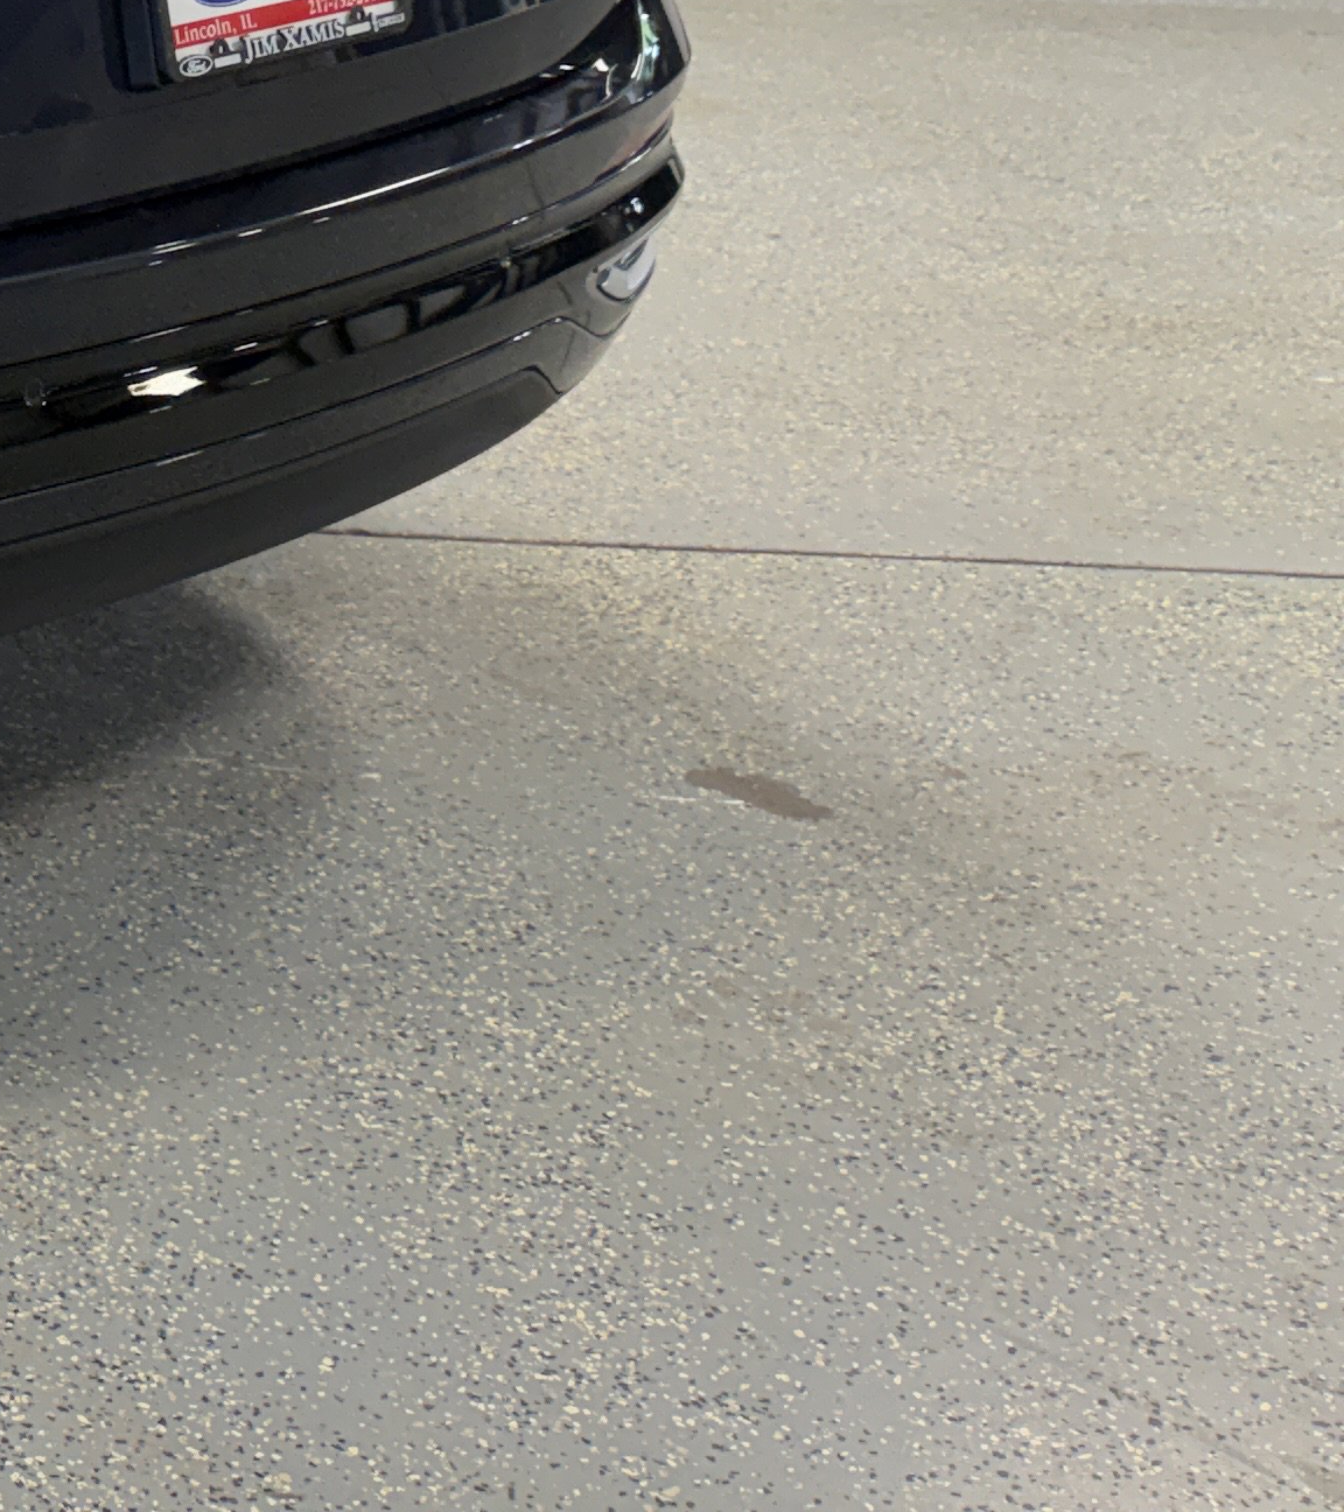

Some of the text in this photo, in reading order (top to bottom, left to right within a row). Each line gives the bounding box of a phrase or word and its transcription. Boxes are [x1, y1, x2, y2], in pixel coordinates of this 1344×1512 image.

[174, 15, 258, 46] Lincoln, IL
[243, 20, 345, 65] JIM XAMIS
